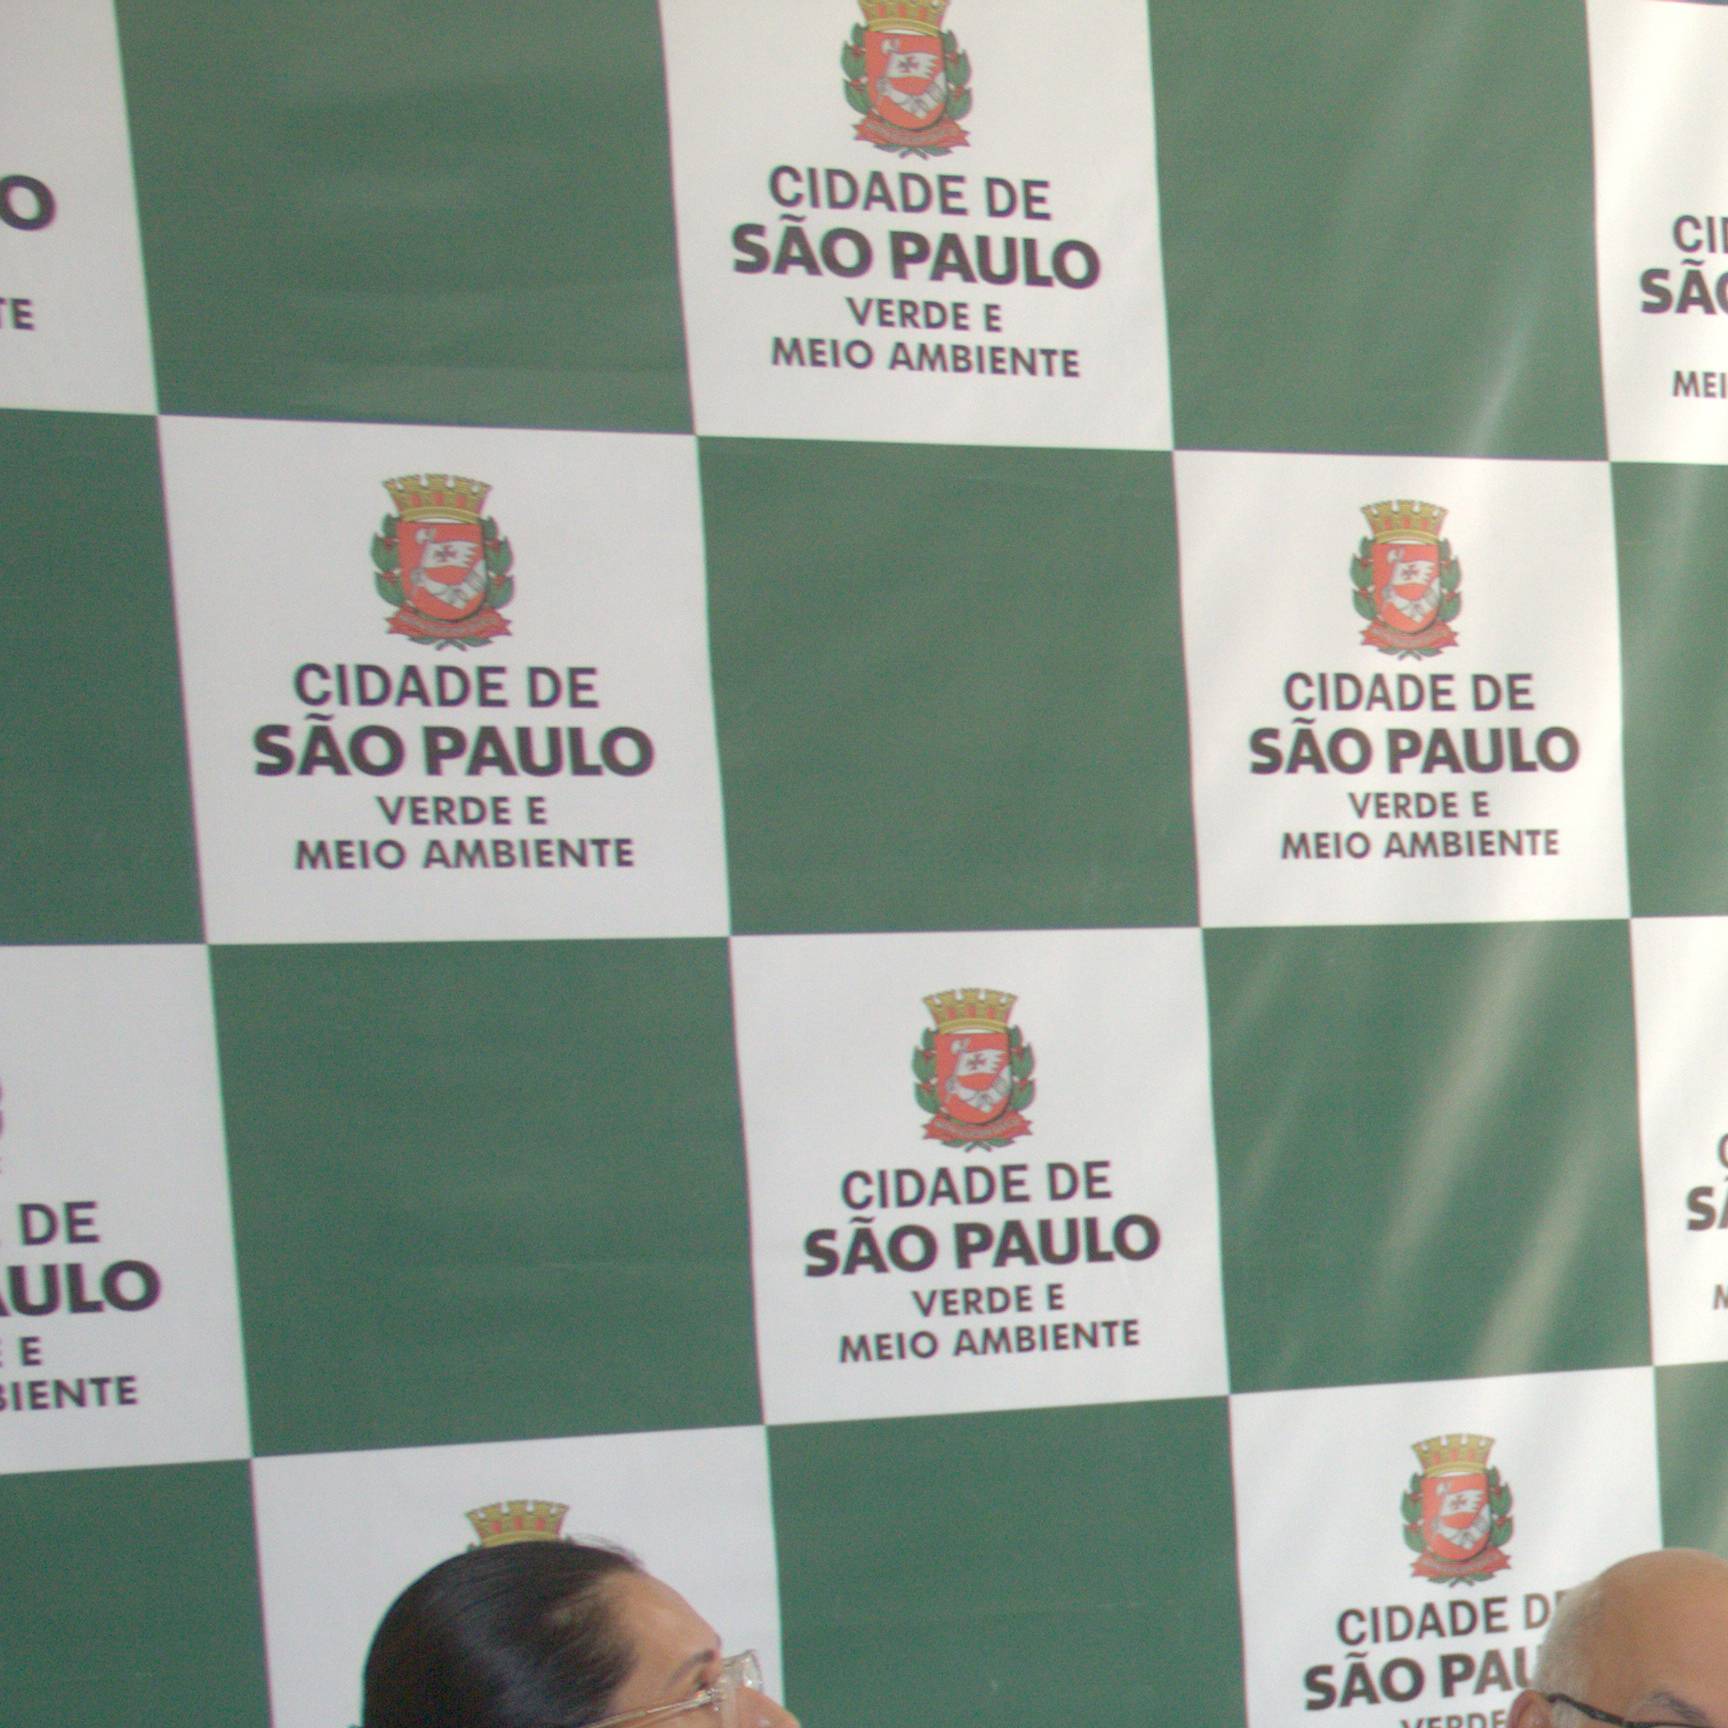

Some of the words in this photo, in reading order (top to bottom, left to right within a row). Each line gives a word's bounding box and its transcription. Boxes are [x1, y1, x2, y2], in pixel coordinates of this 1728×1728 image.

[769, 165, 967, 215] CIDADE
[985, 177, 1050, 220] DE
[732, 214, 872, 277] SÃO
[890, 231, 1099, 289] PAULO
[846, 297, 969, 330] VERDE
[984, 304, 1001, 332] E
[772, 337, 873, 369] MEIO
[889, 342, 1079, 377] AMBIENTE
[294, 663, 507, 707] CIDADE
[528, 666, 598, 708] DE
[1284, 672, 1455, 711] CIDADE
[1472, 673, 1534, 711] DE
[254, 713, 404, 776] SÃO
[423, 726, 653, 776] PAULO
[1249, 717, 1372, 774] SÃO
[1387, 727, 1578, 774] PAULO
[377, 796, 510, 825] VERDE
[527, 796, 546, 825] E
[1349, 791, 1458, 818] VERDE
[1472, 791, 1488, 817] E
[296, 839, 405, 869] MEIO
[423, 838, 633, 868] AMBIENTE
[1282, 832, 1370, 859] MEIO
[1384, 829, 1557, 858] AMBIENTE
[842, 1164, 1029, 1210] CIDADE
[1047, 1161, 1111, 1201] DE
[19, 1201, 98, 1246] DE
[805, 1216, 937, 1277] SÃO
[954, 1214, 1159, 1269] PAULO
[0, 1260, 159, 1316] ULO
[912, 1285, 1032, 1317] VERDE
[1047, 1283, 1063, 1310] E
[20, 1337, 41, 1366] E
[840, 1331, 938, 1363] MEIO
[953, 1319, 1138, 1356] AMBIENTE
[0, 1376, 136, 1411] IENTE
[1337, 1597, 1507, 1646] CIDADE
[1524, 1590, 1569, 1634] D
[1304, 1652, 1424, 1711] SÃO
[1439, 1647, 1534, 1699] PAU
